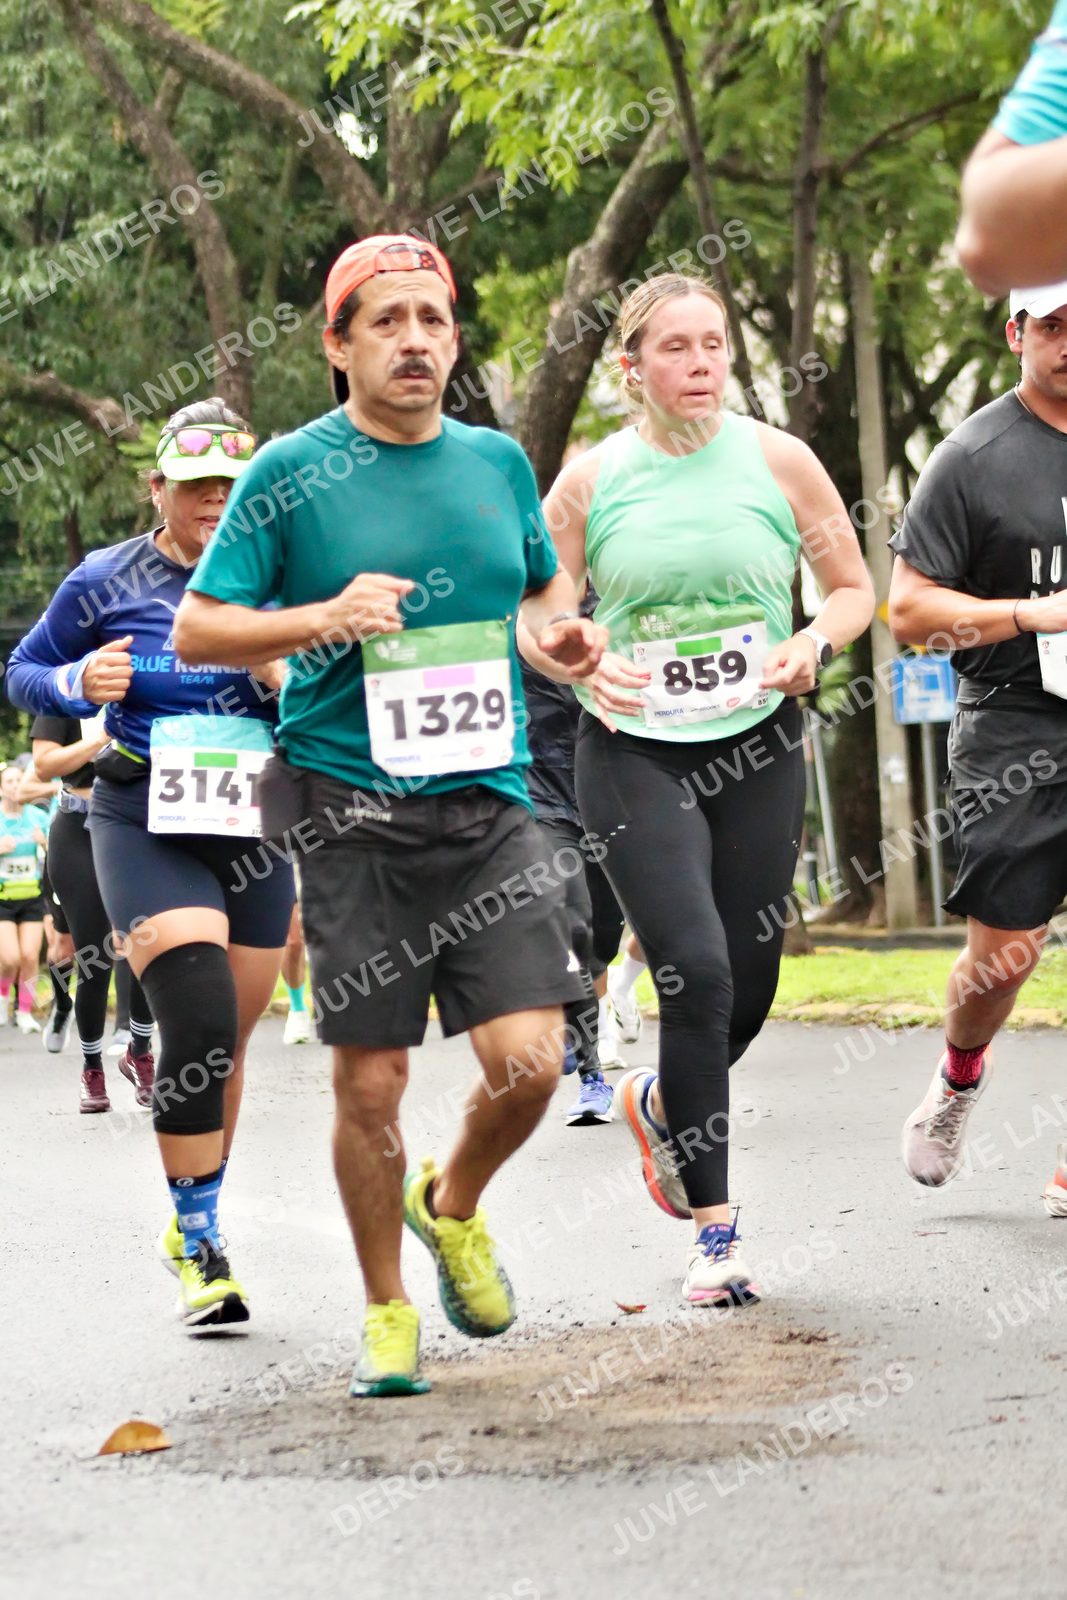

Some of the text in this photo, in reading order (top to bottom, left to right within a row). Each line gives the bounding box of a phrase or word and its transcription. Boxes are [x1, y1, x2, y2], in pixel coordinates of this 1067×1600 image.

[130, 655, 173, 673] BLUE
[663, 650, 747, 696] 859
[384, 688, 506, 741] 1329
[158, 768, 263, 807] 3141
